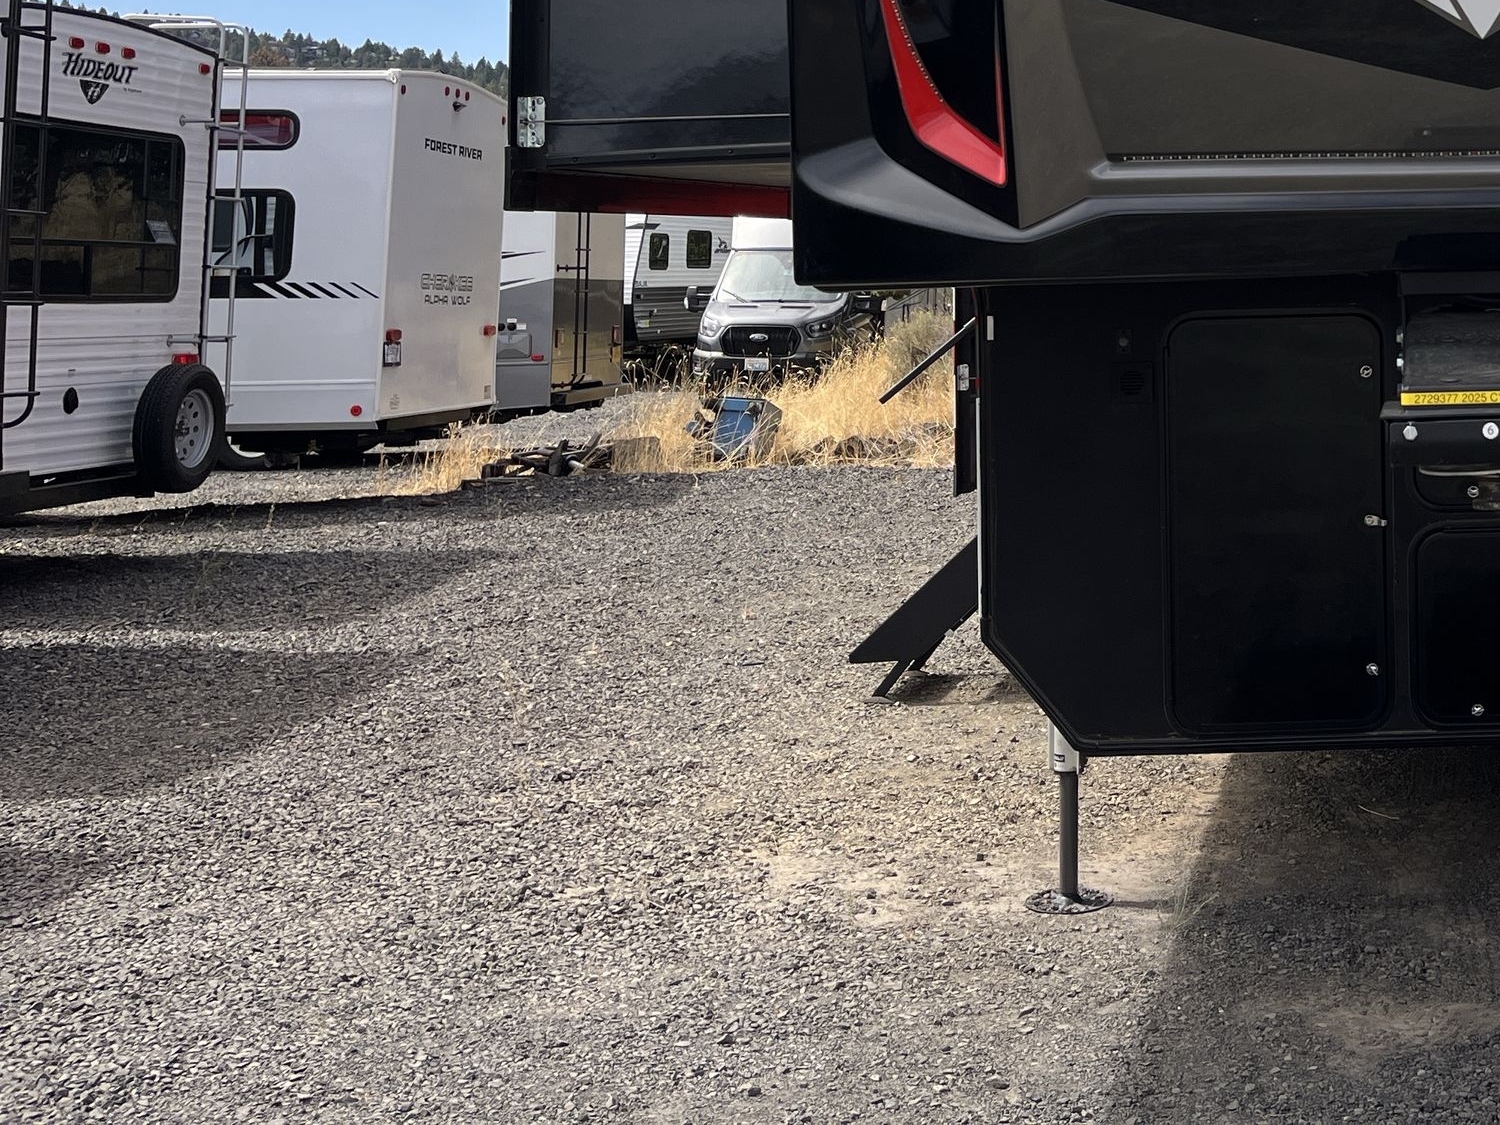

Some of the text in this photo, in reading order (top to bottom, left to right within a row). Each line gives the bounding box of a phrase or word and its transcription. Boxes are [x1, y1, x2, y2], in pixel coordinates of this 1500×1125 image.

[62, 52, 139, 84] HIDEOUT
[425, 138, 483, 160] FOREST RIVER
[1414, 394, 1459, 403] 2729377
[1462, 393, 1487, 403] 2025
